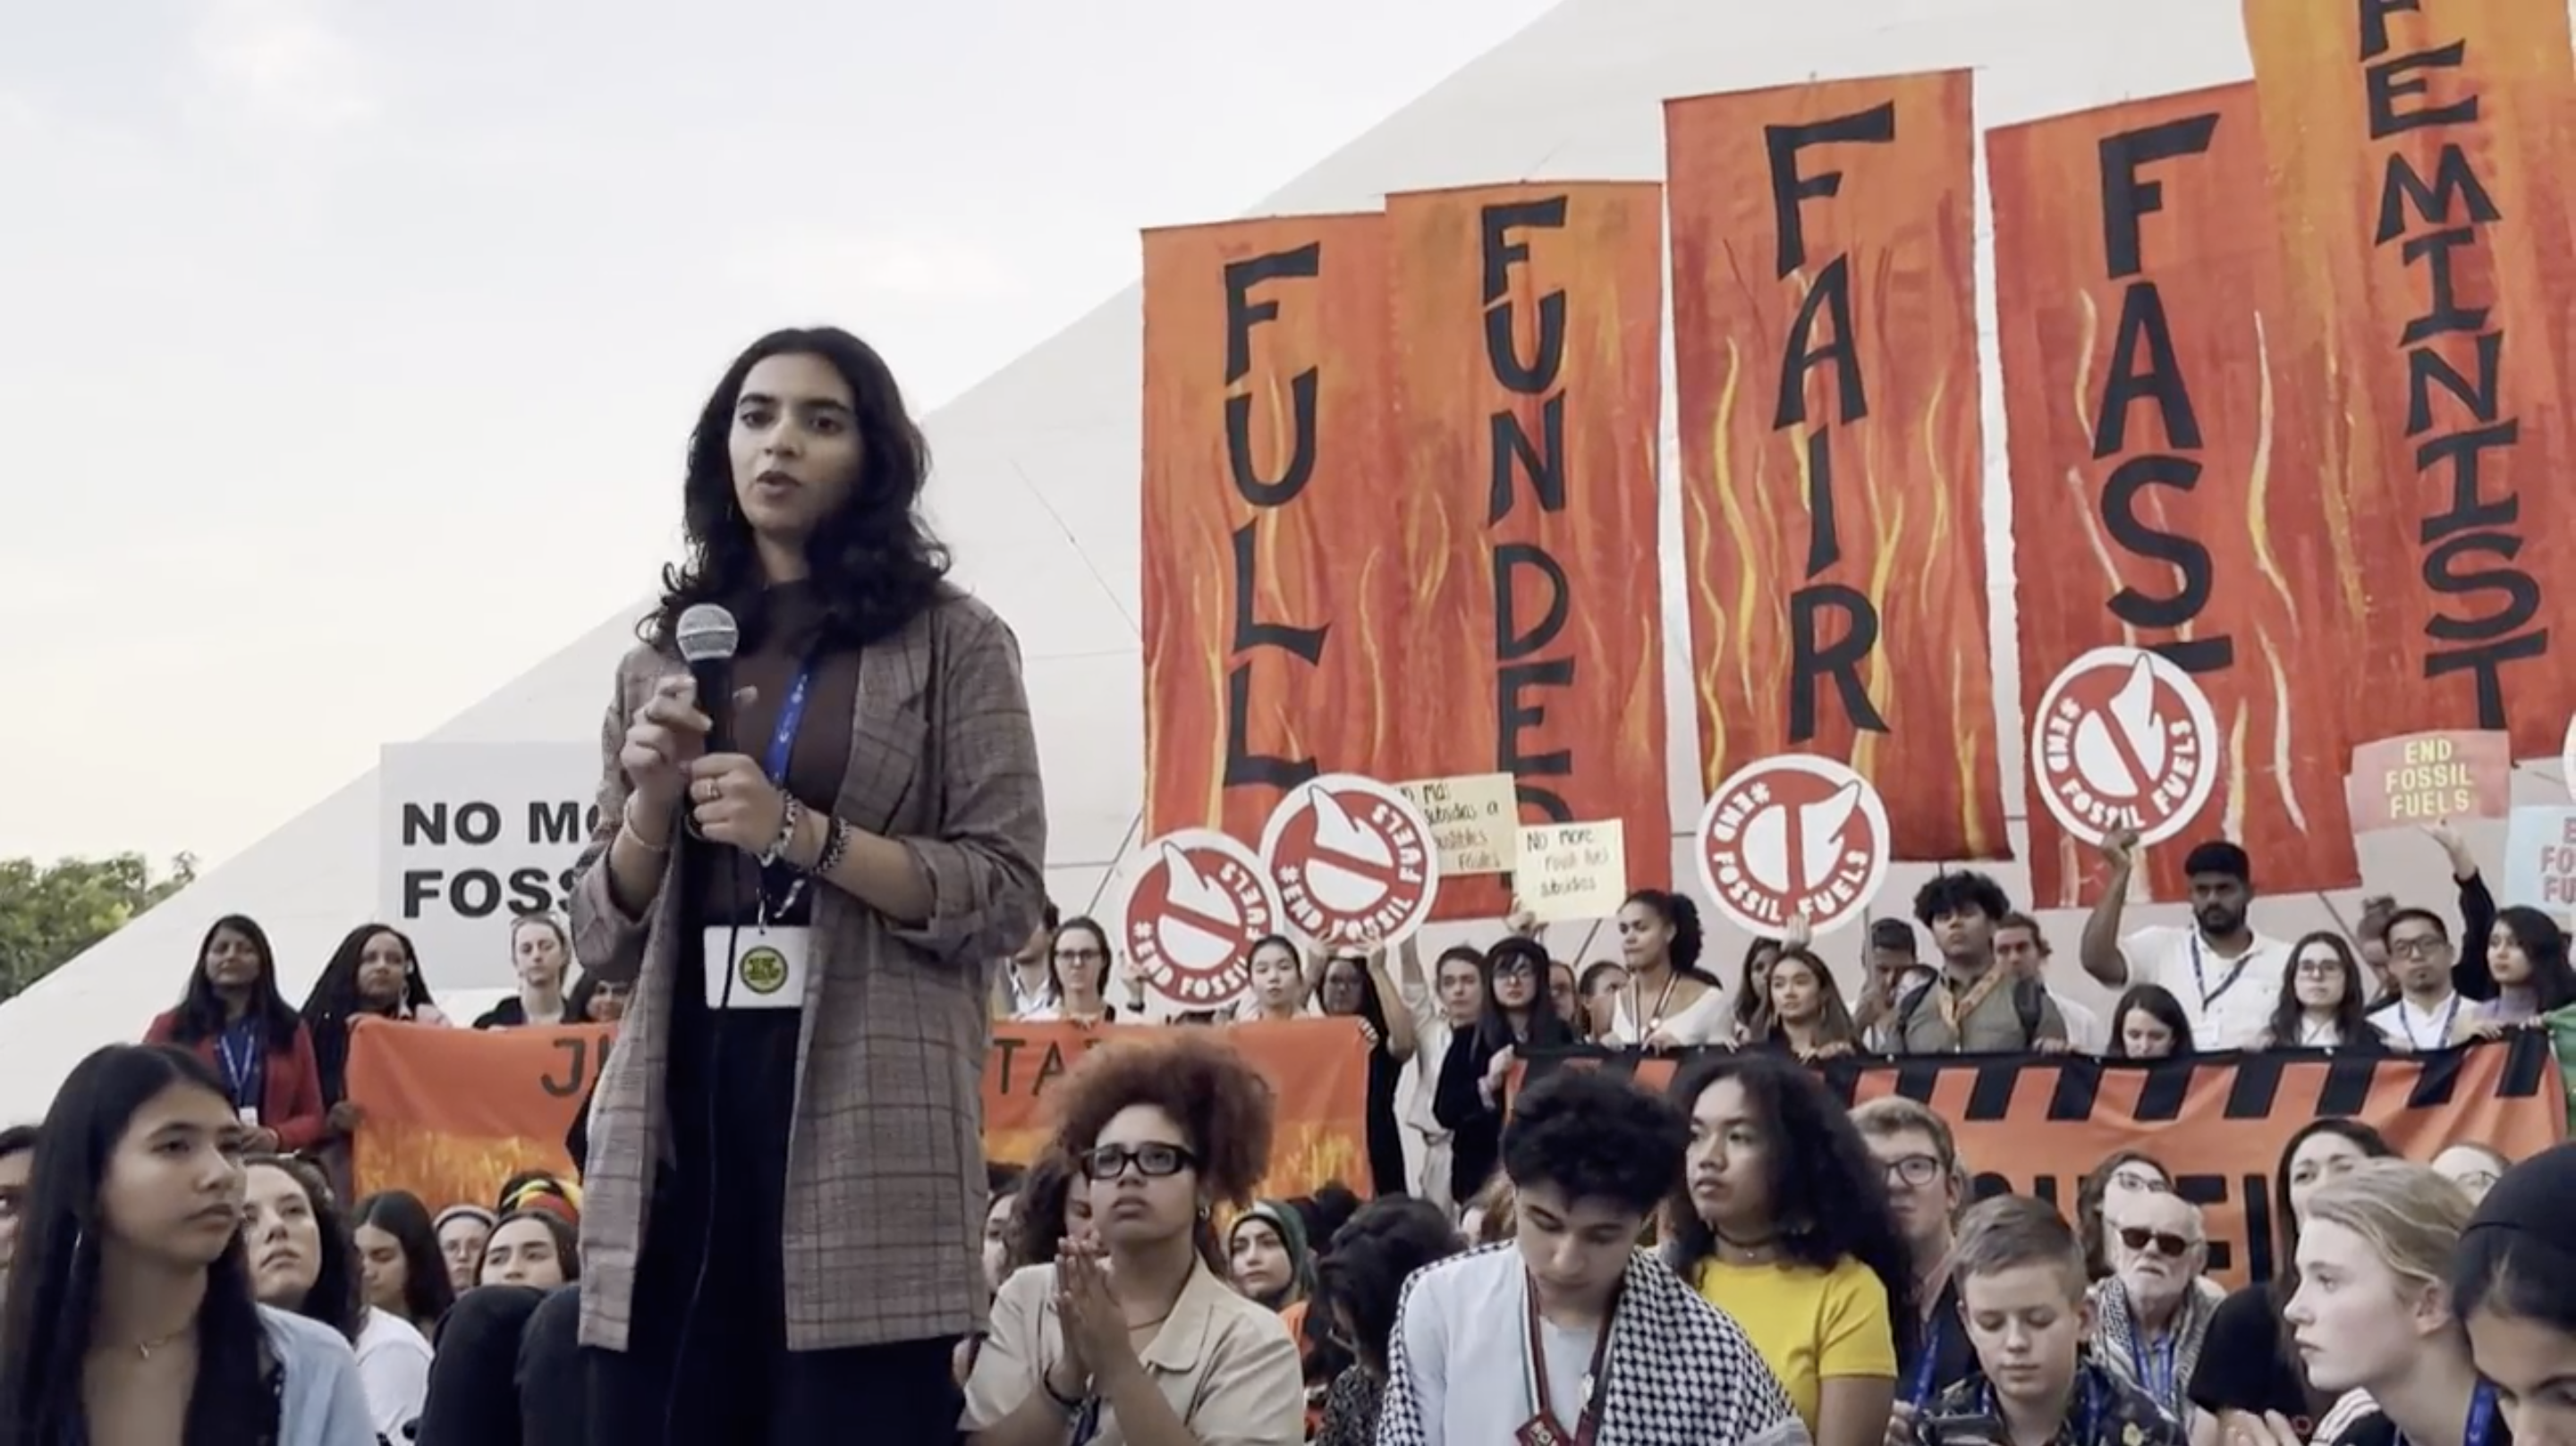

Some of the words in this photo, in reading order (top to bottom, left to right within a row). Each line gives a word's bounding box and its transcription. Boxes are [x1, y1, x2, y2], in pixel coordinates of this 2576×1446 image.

[1766, 100, 1894, 744] FAIR
[1224, 241, 1331, 788] FULL
[2046, 697, 2081, 773] #END
[2151, 720, 2196, 816] FUELS
[2404, 738, 2452, 764] END
[1713, 782, 1770, 842] #END
[2060, 778, 2146, 829] FOSSIL
[2385, 764, 2473, 794] FOSSIL
[2390, 789, 2470, 819] FUELS
[402, 801, 501, 845] NO
[1219, 862, 1267, 940] FUELS
[1278, 864, 1323, 930] #END
[1371, 805, 1422, 884] FUELS
[1712, 851, 1782, 922] FOSSIL
[1797, 850, 1868, 921] FUELS
